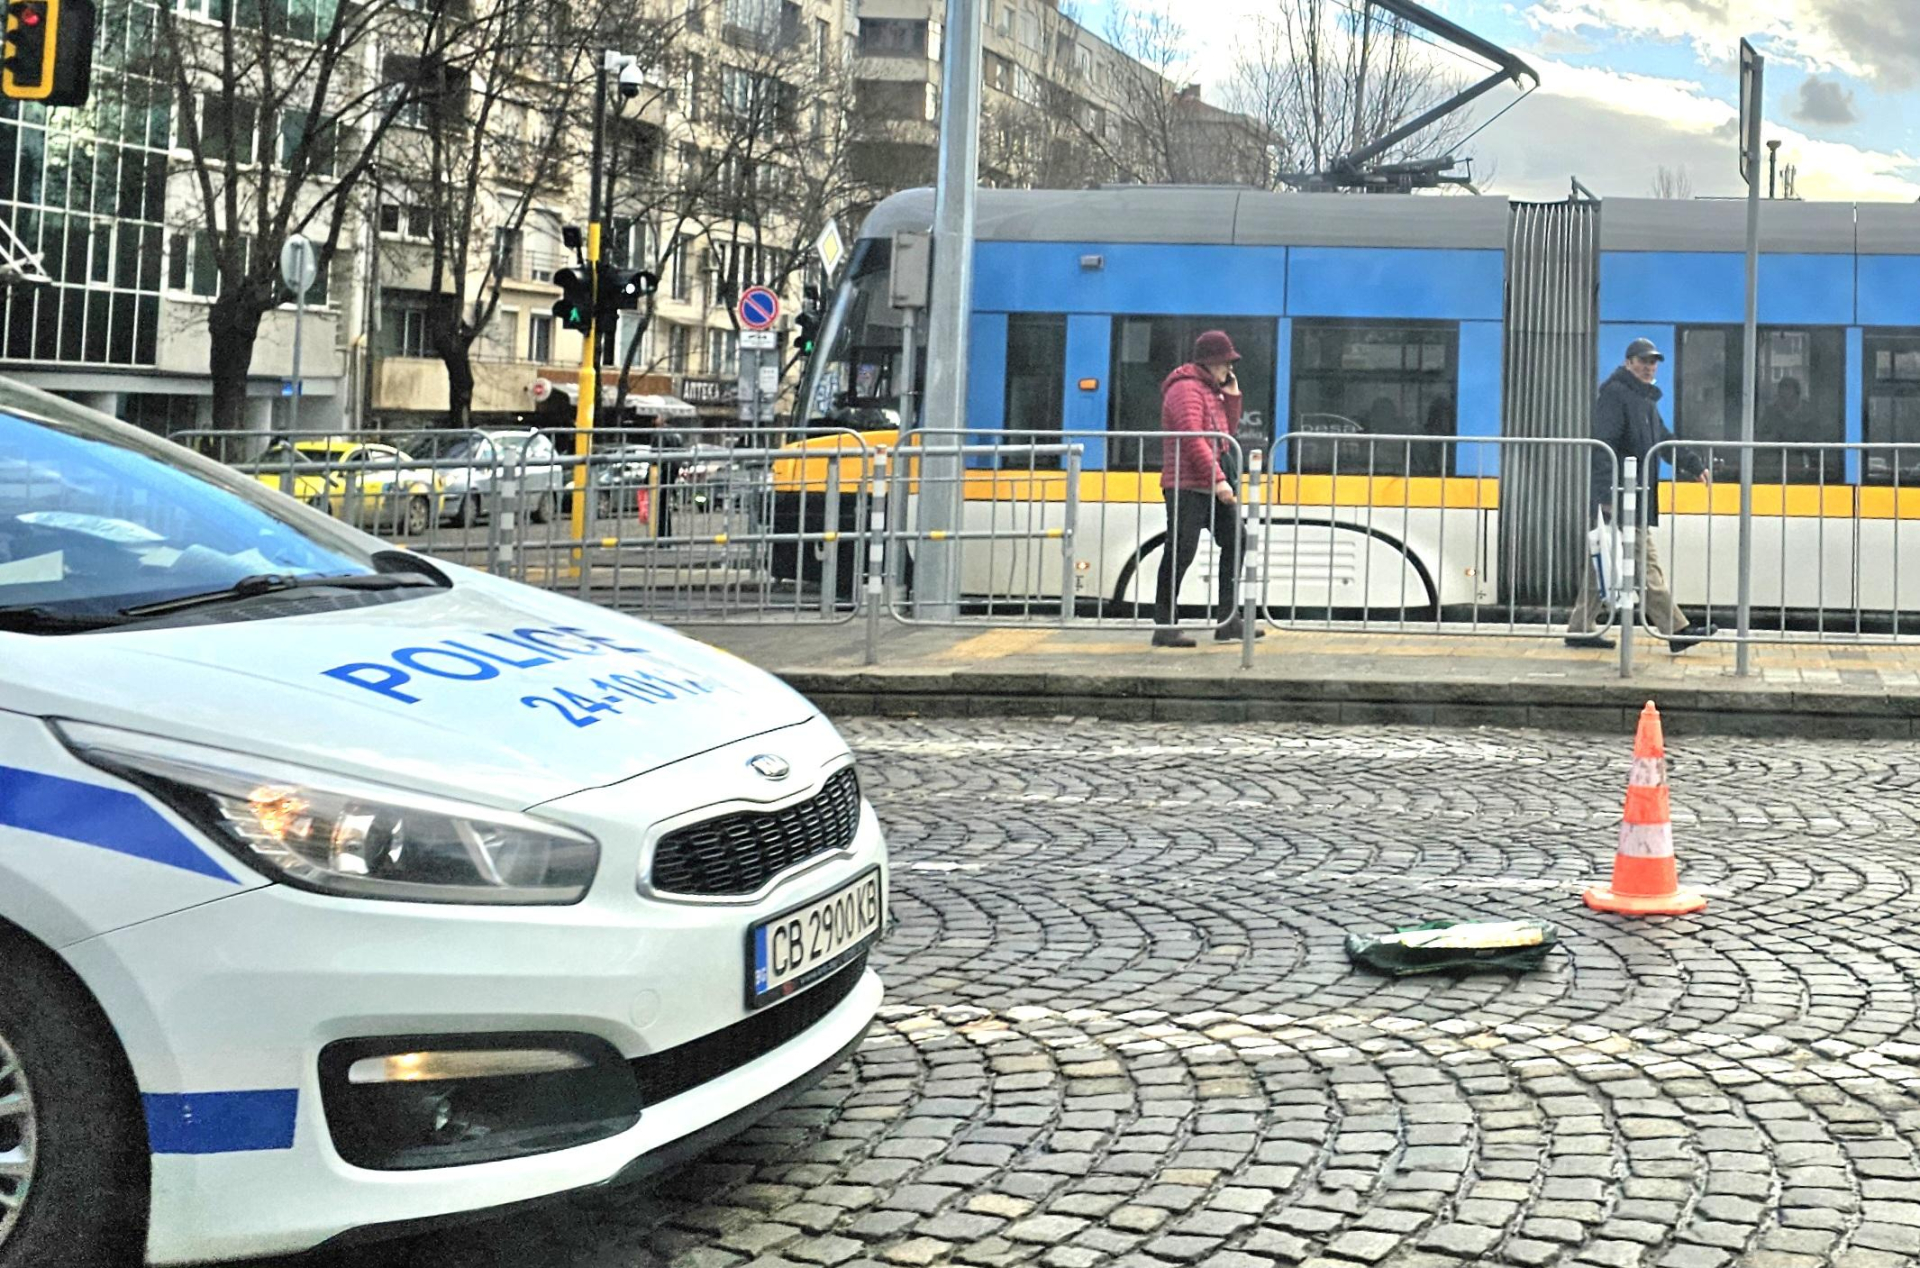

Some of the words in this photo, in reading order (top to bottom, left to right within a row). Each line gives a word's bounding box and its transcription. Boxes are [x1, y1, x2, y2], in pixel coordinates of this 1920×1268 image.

[683, 381, 720, 400] АПТЕКА
[319, 627, 651, 704] POLICE
[772, 919, 804, 977] CB
[809, 892, 855, 961] 2900
[857, 878, 877, 933] KB
